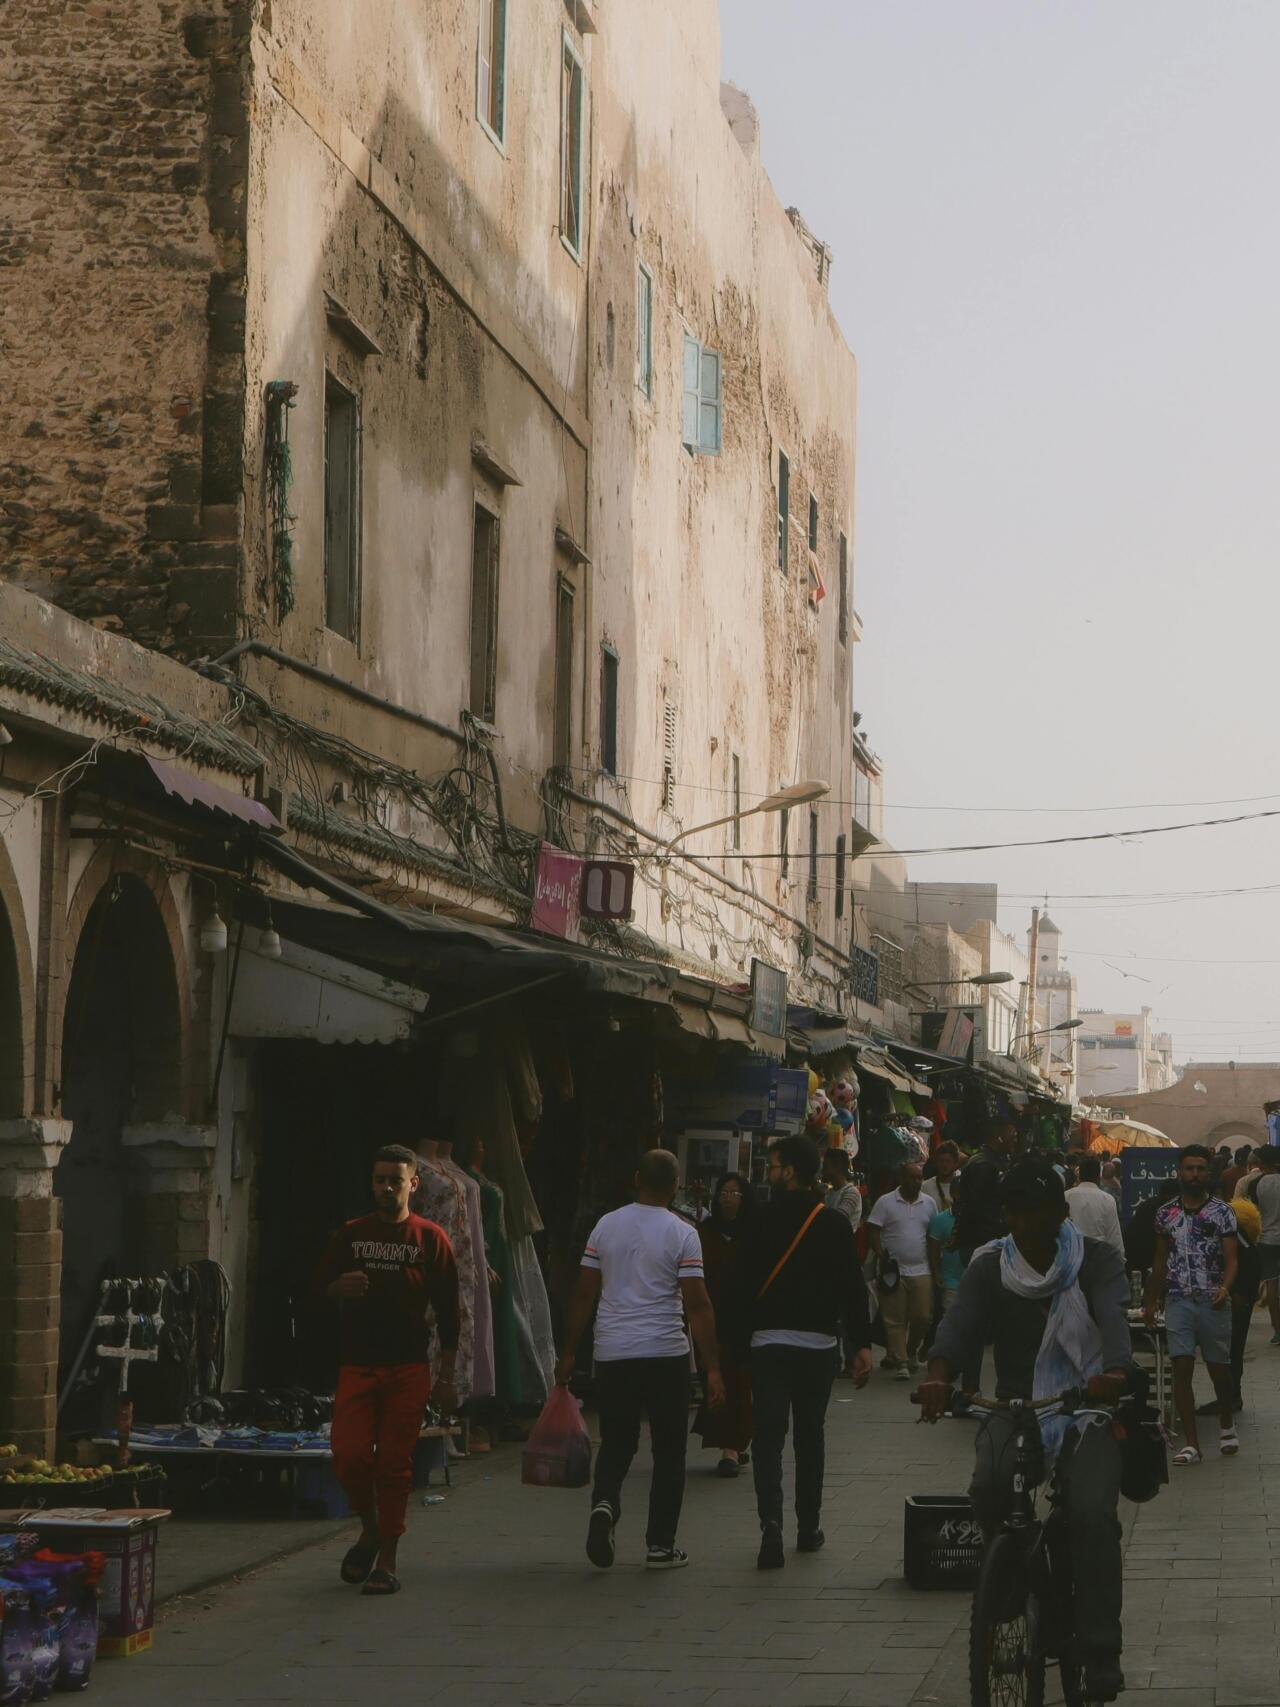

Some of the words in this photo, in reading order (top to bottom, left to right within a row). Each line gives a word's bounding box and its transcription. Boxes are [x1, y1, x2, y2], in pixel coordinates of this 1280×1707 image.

[1130, 1161, 1178, 1181] فندق
[351, 1240, 421, 1264] TOMMY
[365, 1262, 400, 1272] HILFIGER
